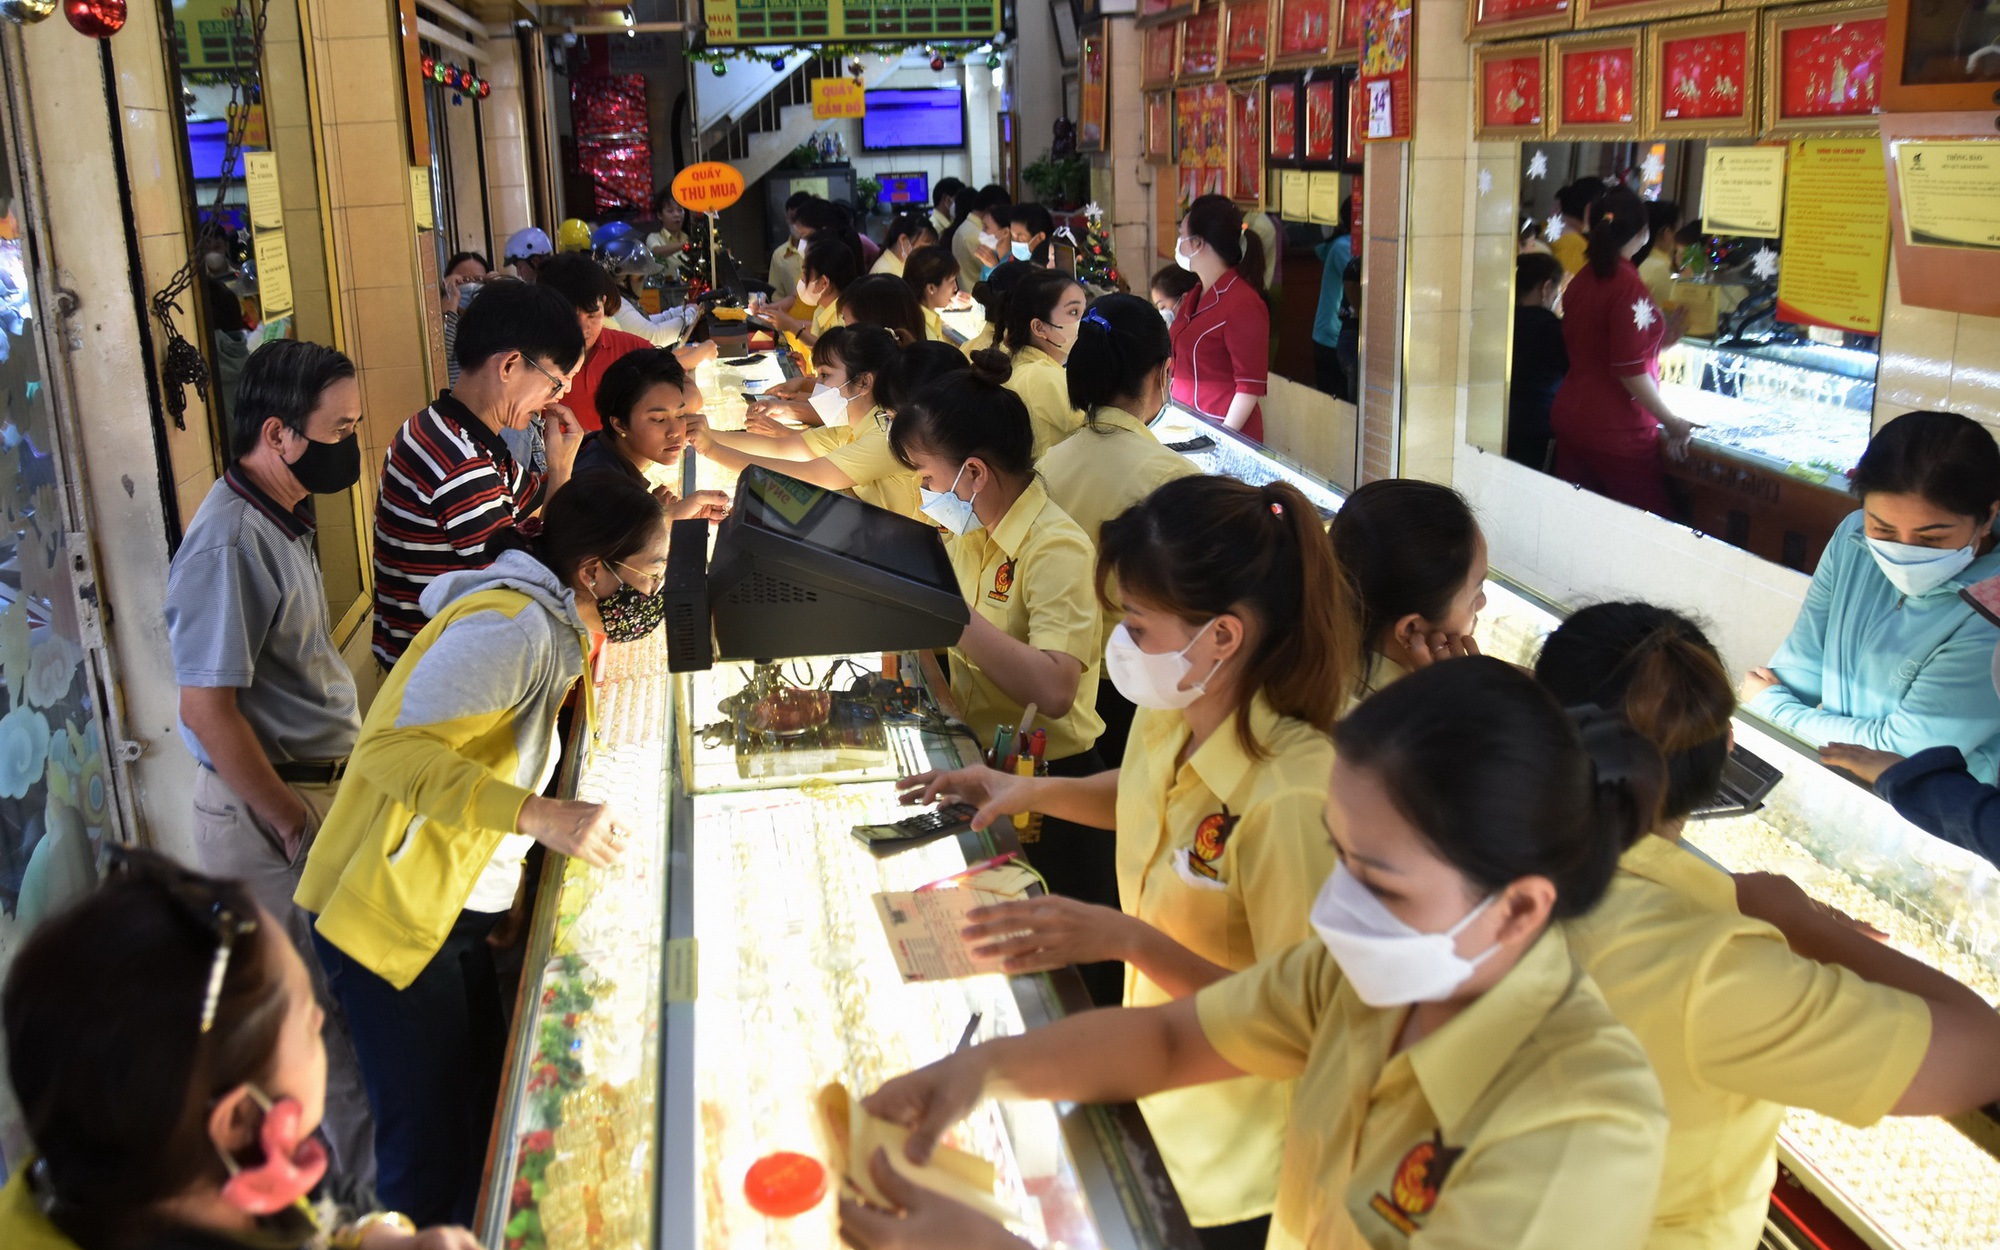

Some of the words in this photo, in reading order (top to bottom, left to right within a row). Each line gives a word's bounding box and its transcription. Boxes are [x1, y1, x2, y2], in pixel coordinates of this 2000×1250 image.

[708, 13, 732, 23] MUA
[680, 186, 706, 202] THU
[710, 182, 738, 199] MUA
